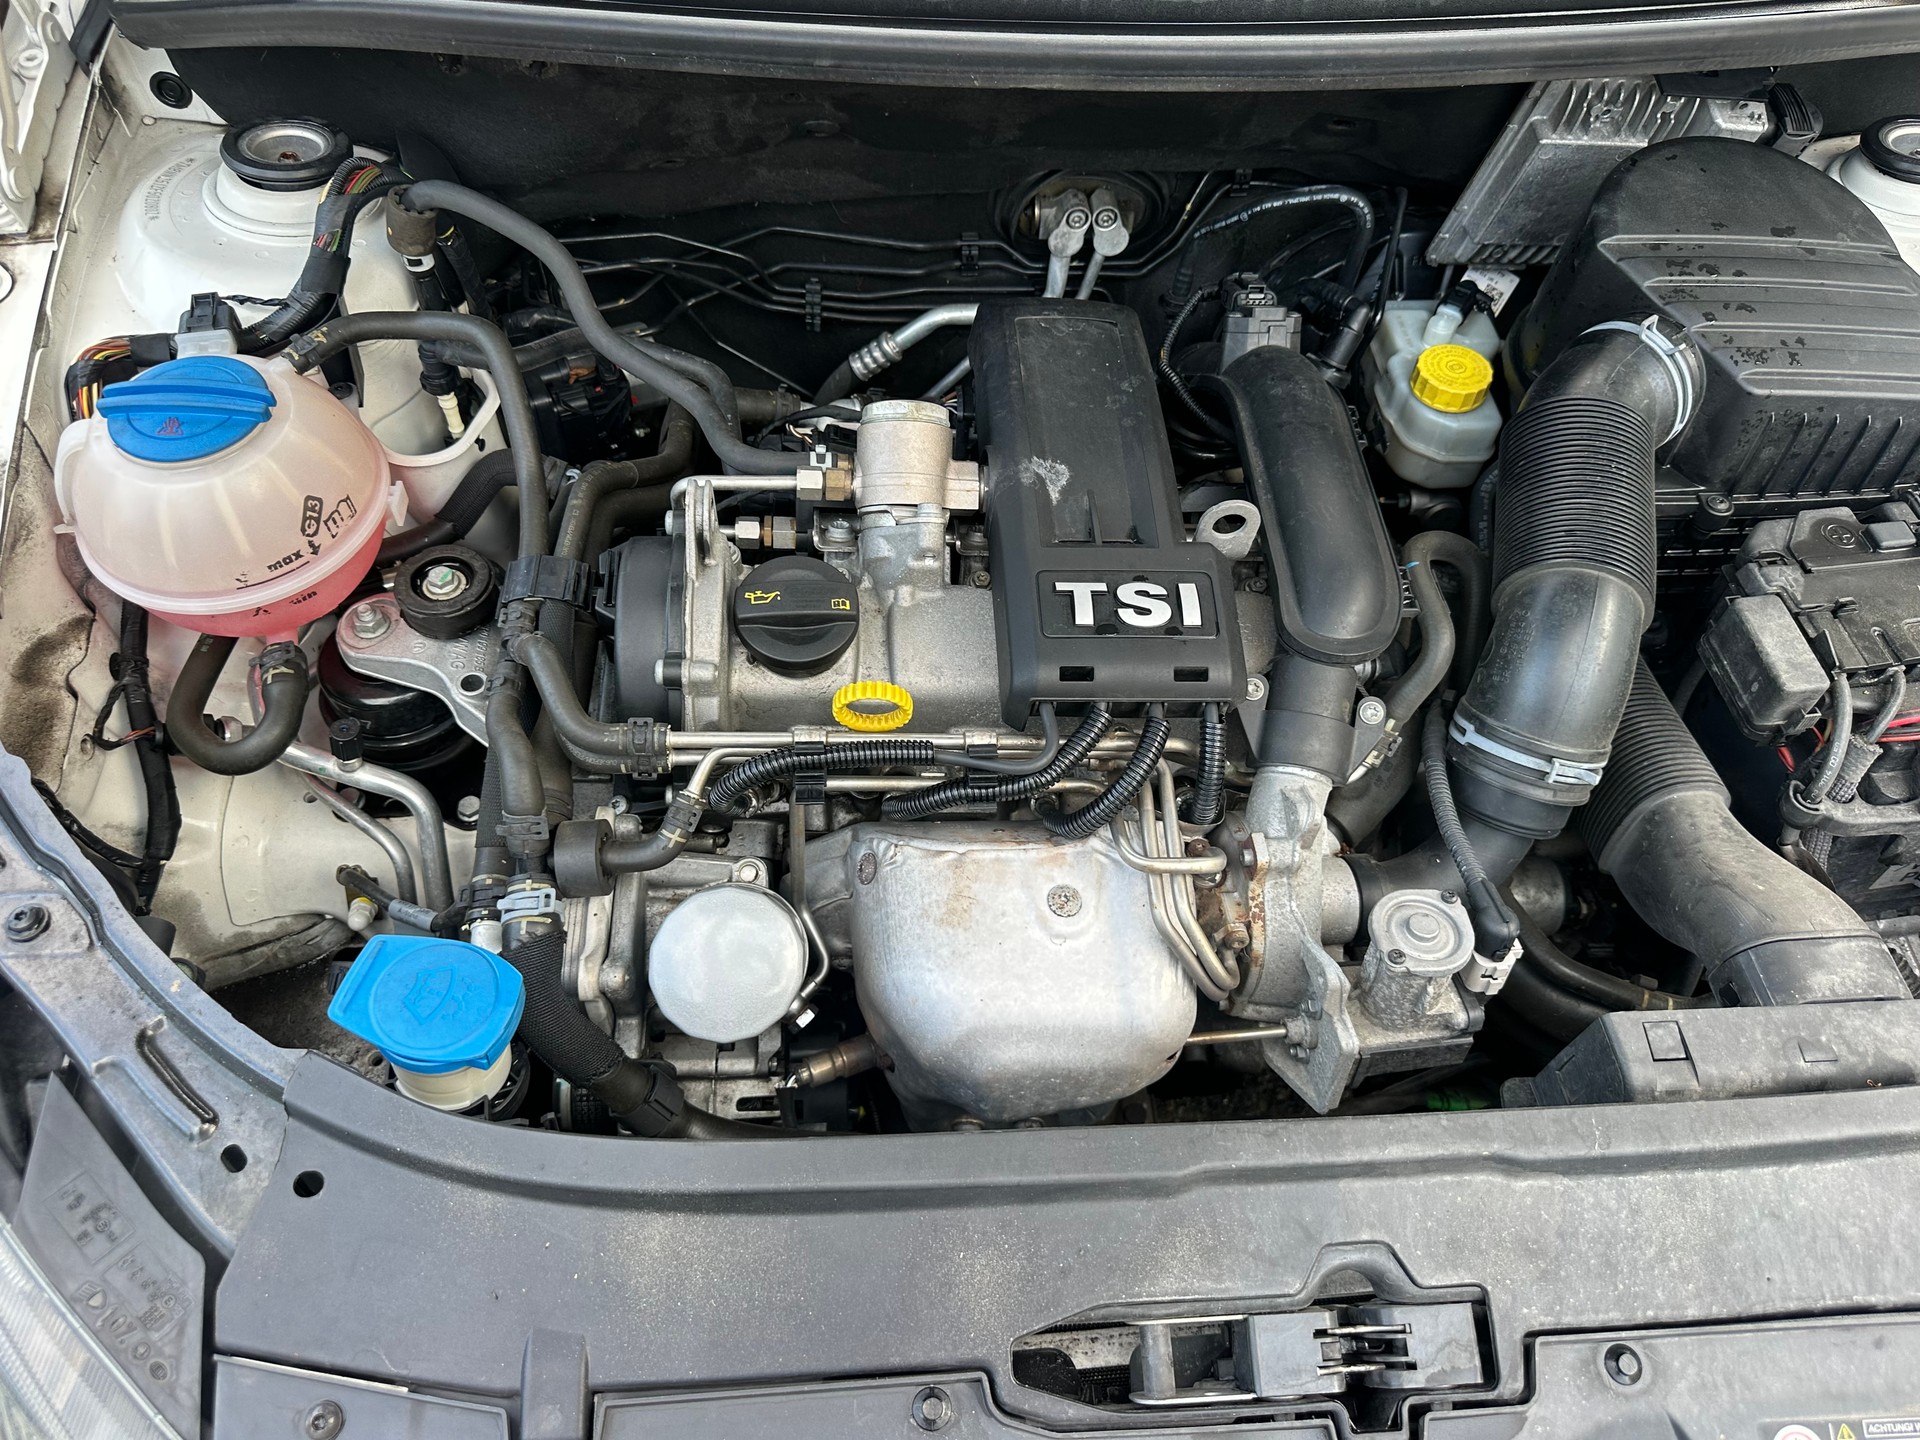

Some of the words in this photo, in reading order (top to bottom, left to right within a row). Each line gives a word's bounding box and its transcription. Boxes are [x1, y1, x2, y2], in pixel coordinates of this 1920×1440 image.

[304, 499, 320, 536] G13
[266, 549, 304, 572] max
[1054, 581, 1202, 627] TSI
[450, 653, 467, 670] AG
